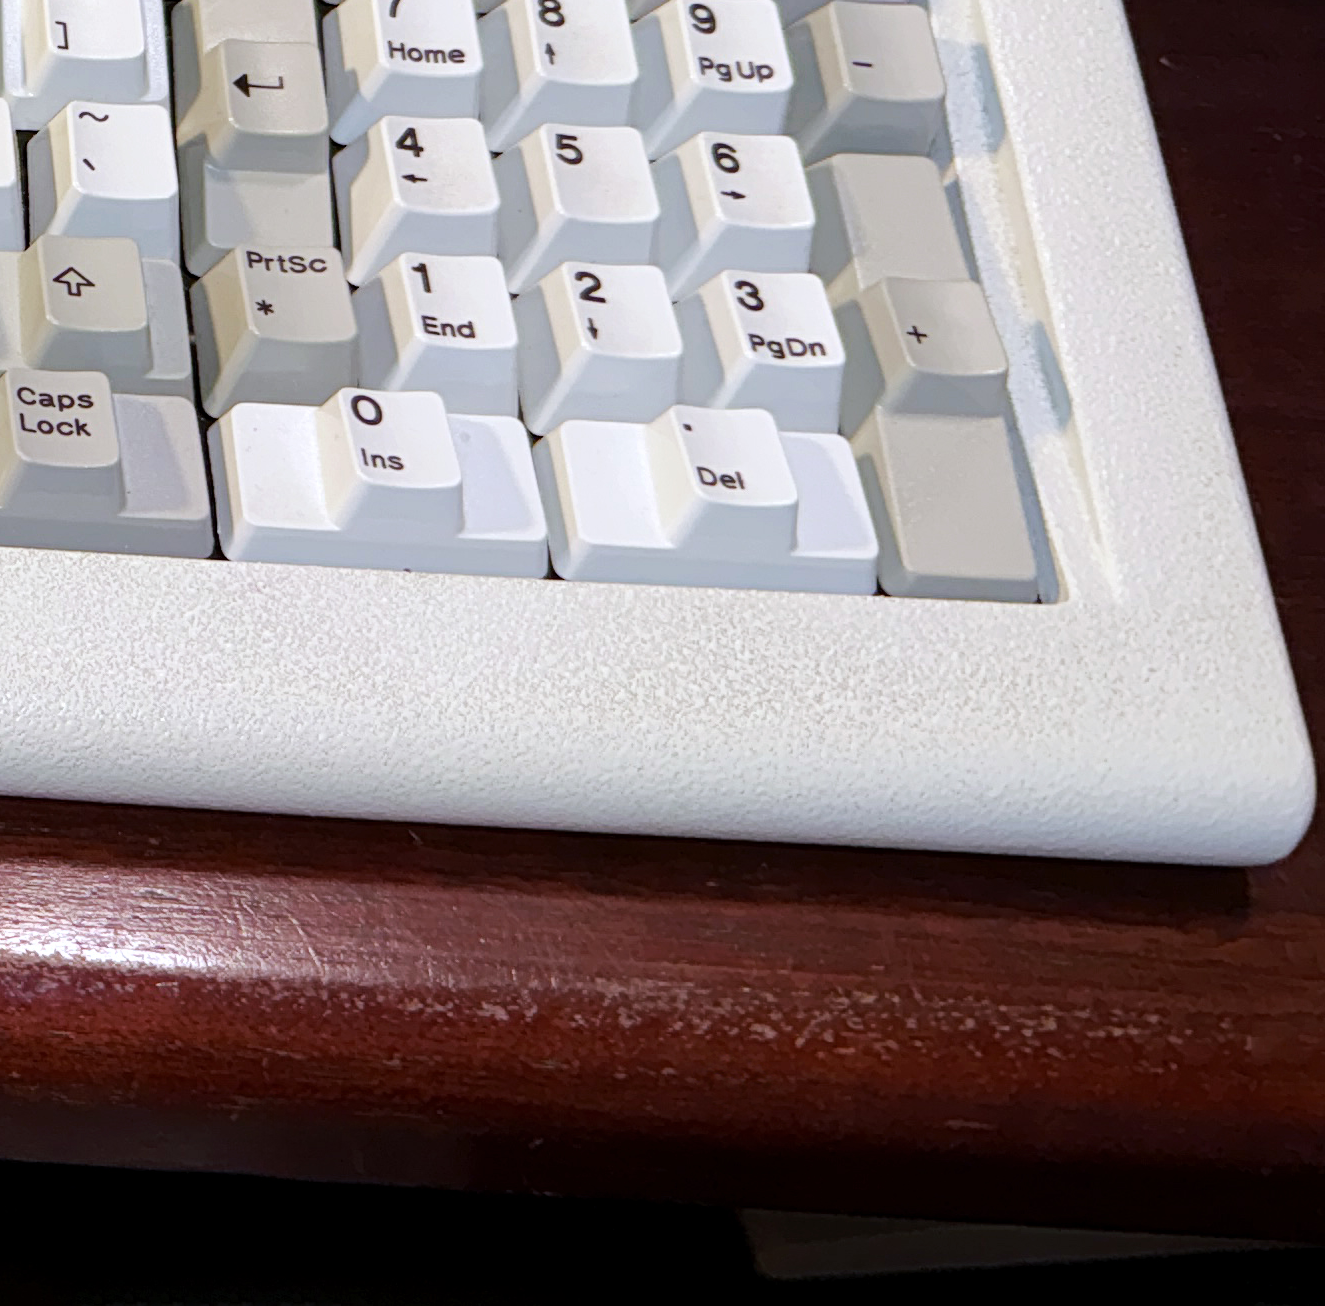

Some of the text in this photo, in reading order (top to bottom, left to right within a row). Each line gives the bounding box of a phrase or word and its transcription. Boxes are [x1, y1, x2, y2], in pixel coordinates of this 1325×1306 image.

[688, 2, 716, 35] 9
[387, 41, 466, 65] Home
[395, 127, 424, 158] 4
[555, 133, 584, 165] 5
[711, 142, 740, 174] 6
[246, 251, 327, 273] PrtSc
[411, 263, 432, 293] 1
[574, 271, 607, 303] 2
[734, 280, 765, 312] 3
[421, 315, 476, 339] End
[748, 333, 827, 360] PgDn
[16, 387, 95, 412] Caps
[18, 411, 92, 437] Lock
[361, 448, 404, 471] Ins
[696, 466, 745, 490] Del
